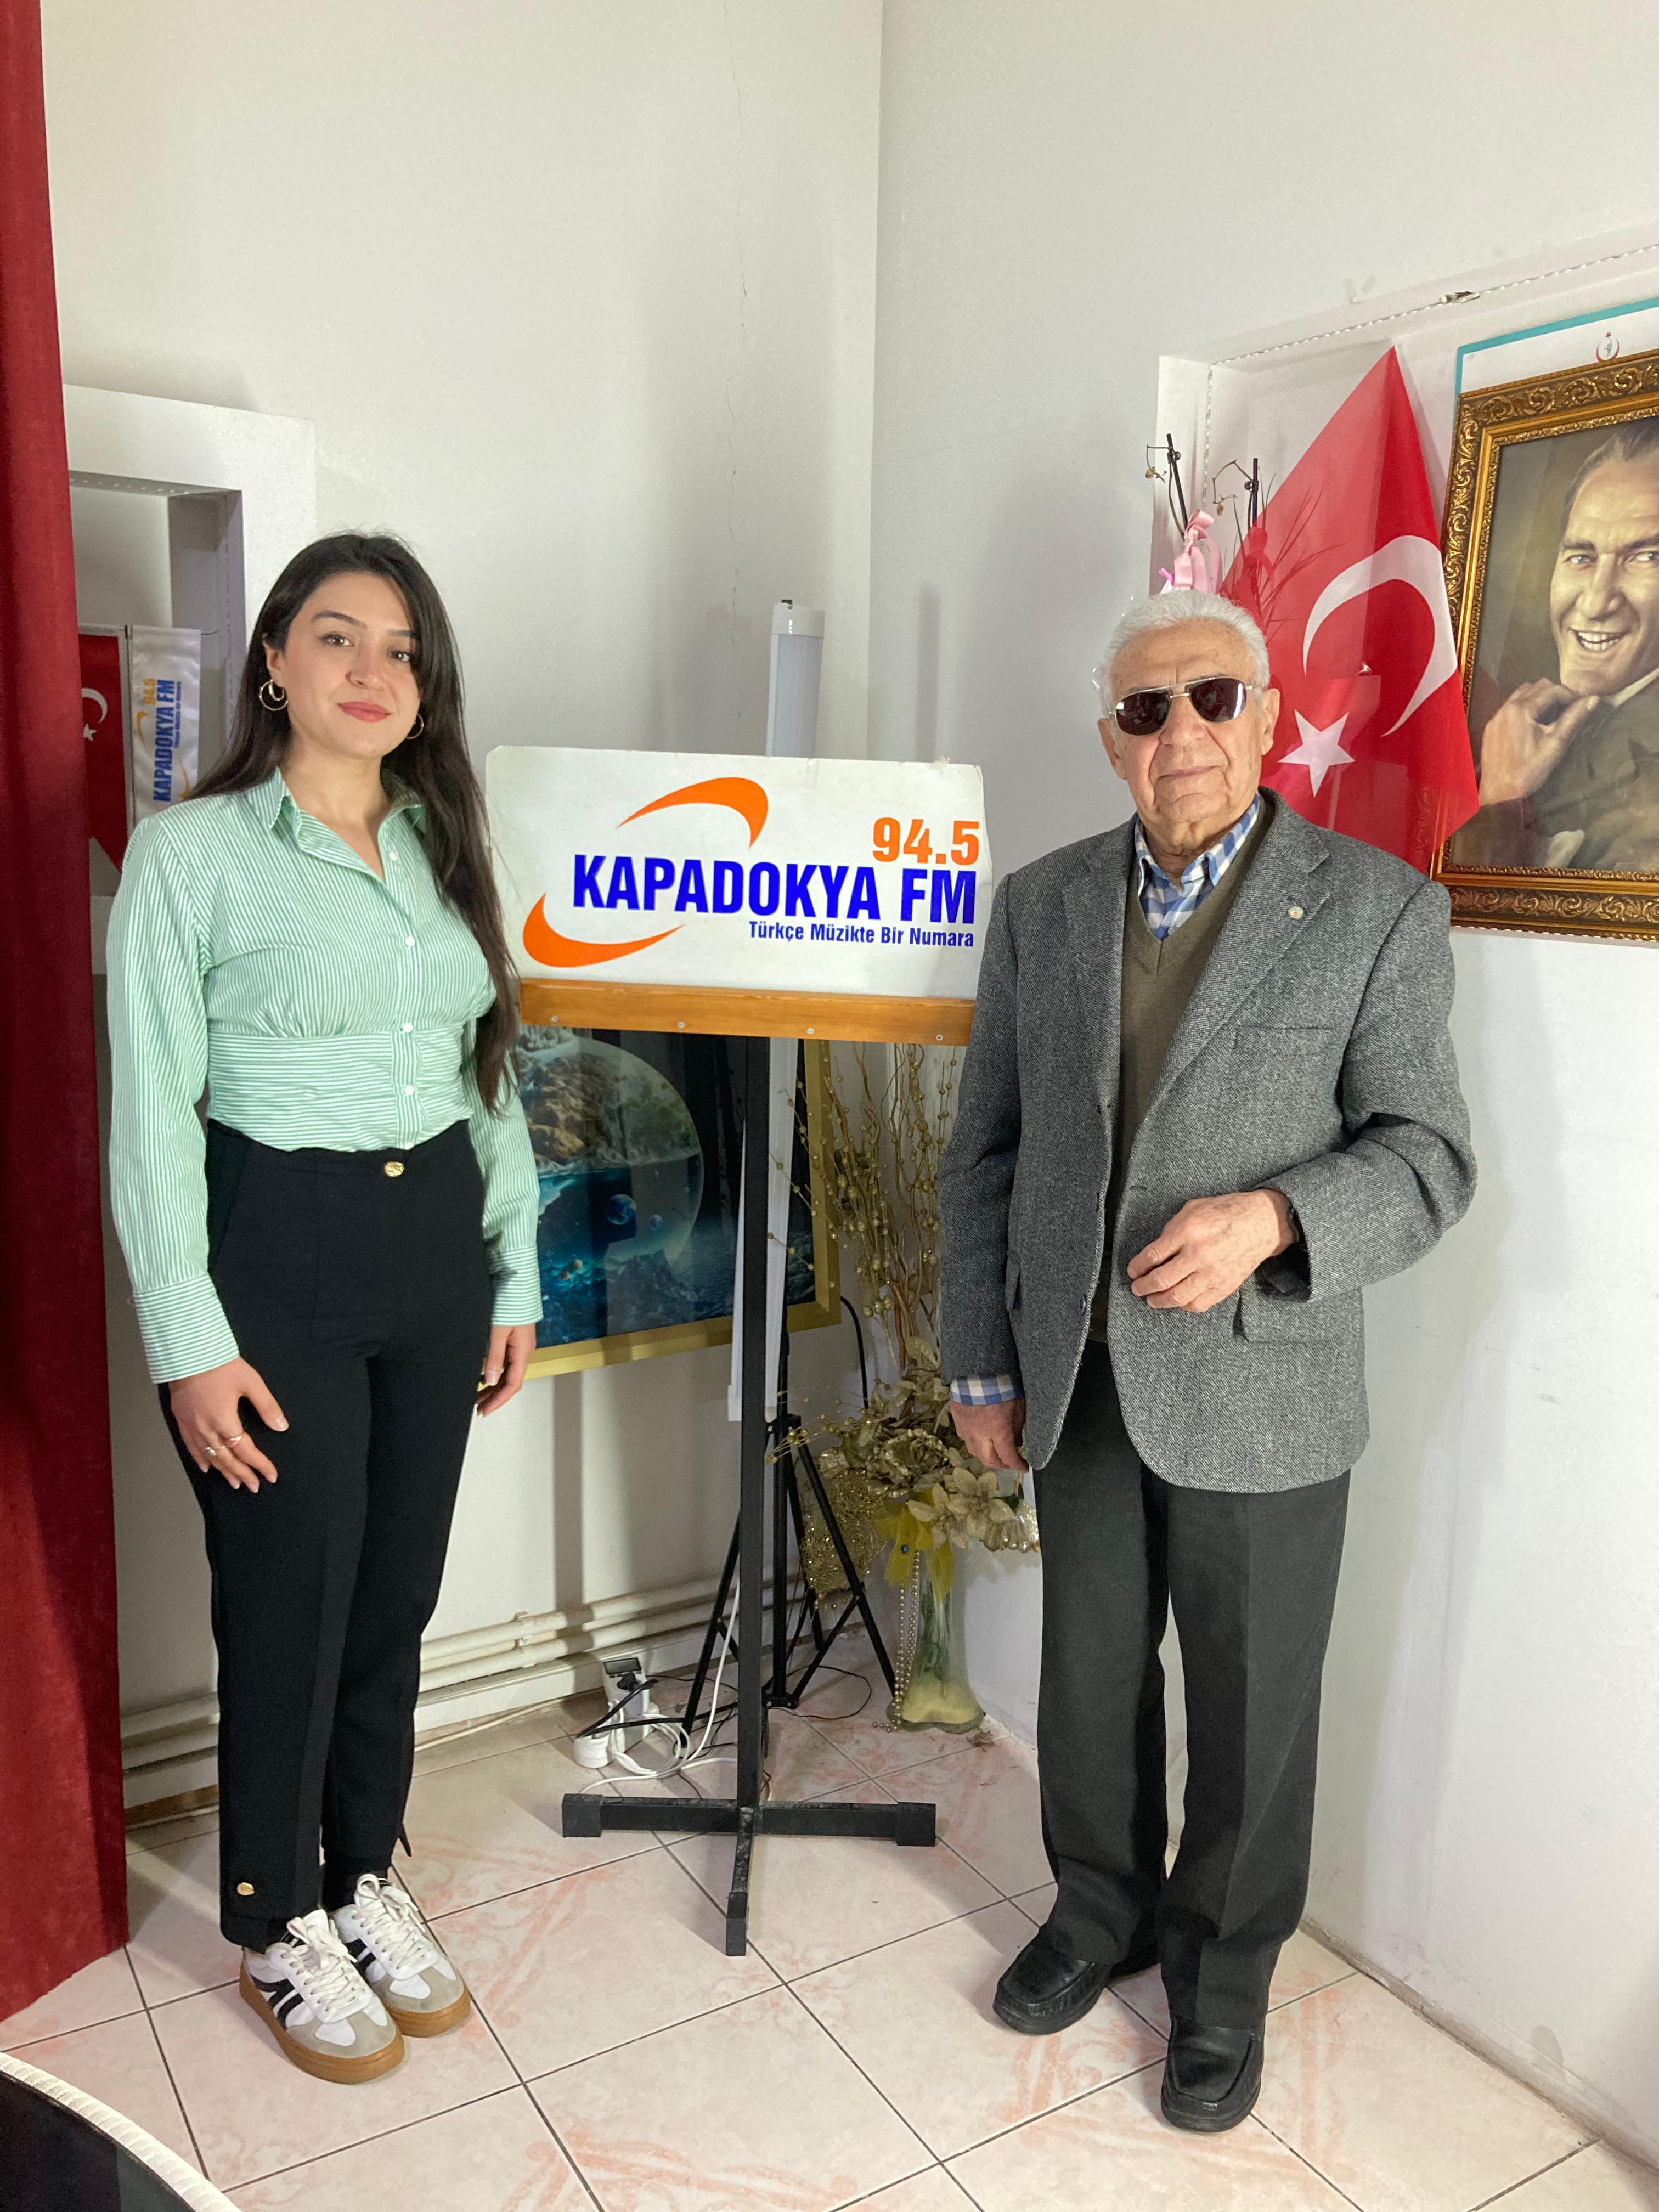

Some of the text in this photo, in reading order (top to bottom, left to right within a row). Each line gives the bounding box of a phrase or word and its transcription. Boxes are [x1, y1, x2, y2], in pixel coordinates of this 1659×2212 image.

[153, 679, 174, 802] KAPADOKYA FM
[872, 816, 980, 866] 94.5
[573, 854, 977, 925] KAPADOKYA FM
[749, 921, 974, 947] Türkçe Müzikte Bir Numara
